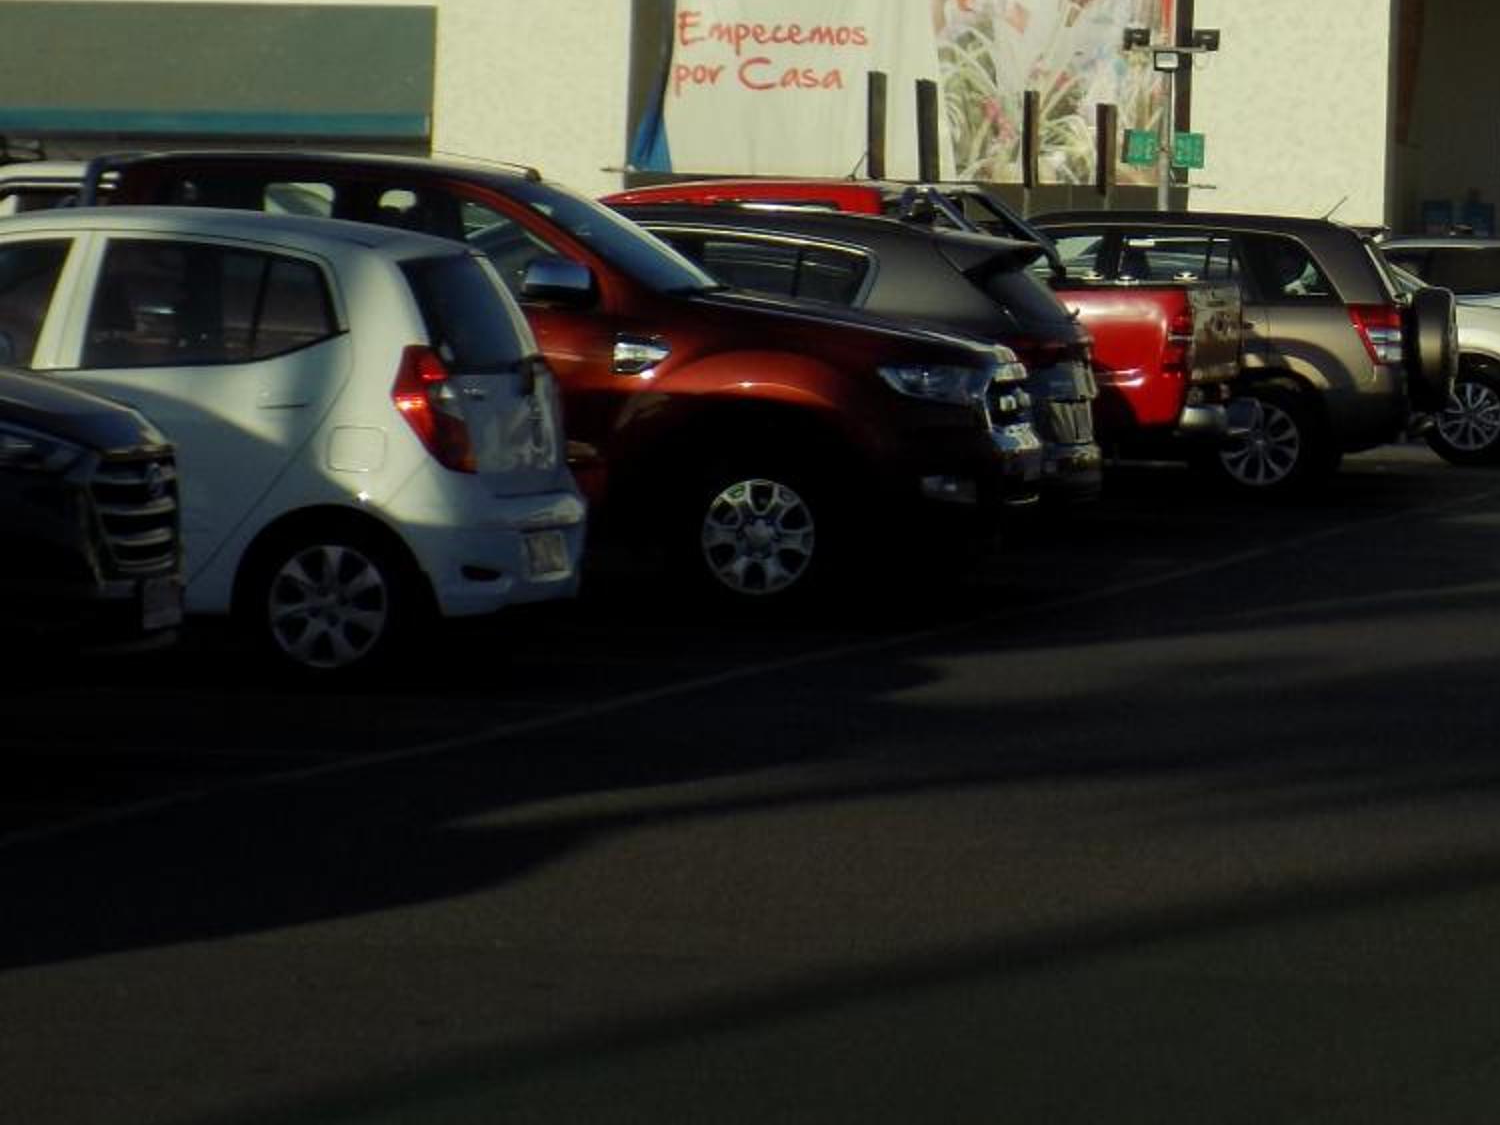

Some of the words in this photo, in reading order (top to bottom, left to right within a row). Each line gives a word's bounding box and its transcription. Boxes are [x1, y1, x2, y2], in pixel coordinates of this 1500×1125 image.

[677, 10, 868, 56] Empecemos
[672, 64, 724, 97] por
[738, 57, 843, 90] Casa
